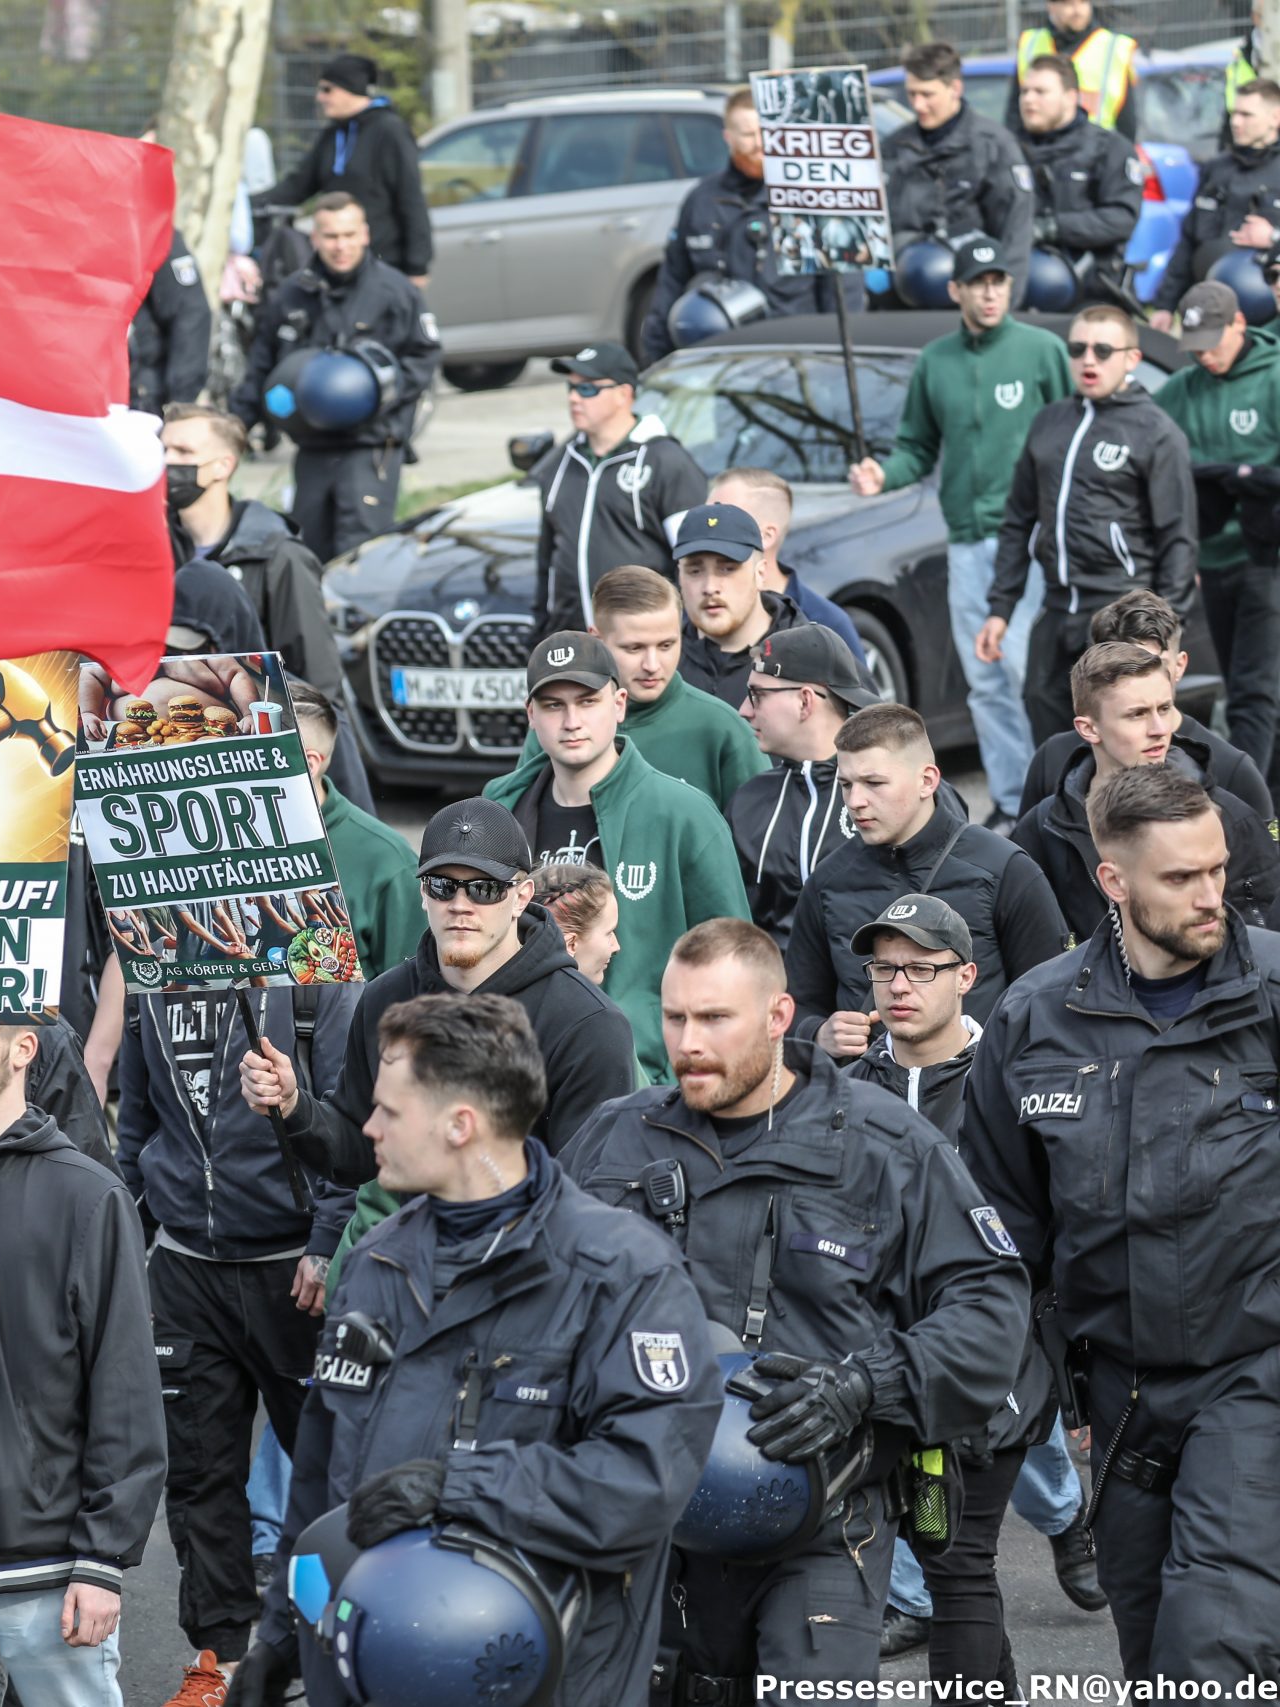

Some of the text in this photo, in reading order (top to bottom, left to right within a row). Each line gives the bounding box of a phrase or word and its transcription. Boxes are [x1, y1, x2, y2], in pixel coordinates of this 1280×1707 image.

[762, 129, 872, 157] KRIEG
[783, 161, 851, 182] DEN
[770, 188, 879, 208] DROGEN!
[77, 746, 290, 792] ERNÄHRUNGSLEHRE &
[100, 785, 289, 859] SPORT
[107, 852, 323, 900] ZU HAUPTFÄCHERN!
[166, 967, 183, 976] AG
[185, 963, 235, 976] KÖRPER
[239, 963, 249, 973] &
[1019, 1092, 1083, 1118] POLIZEI
[817, 1239, 847, 1258] 68283
